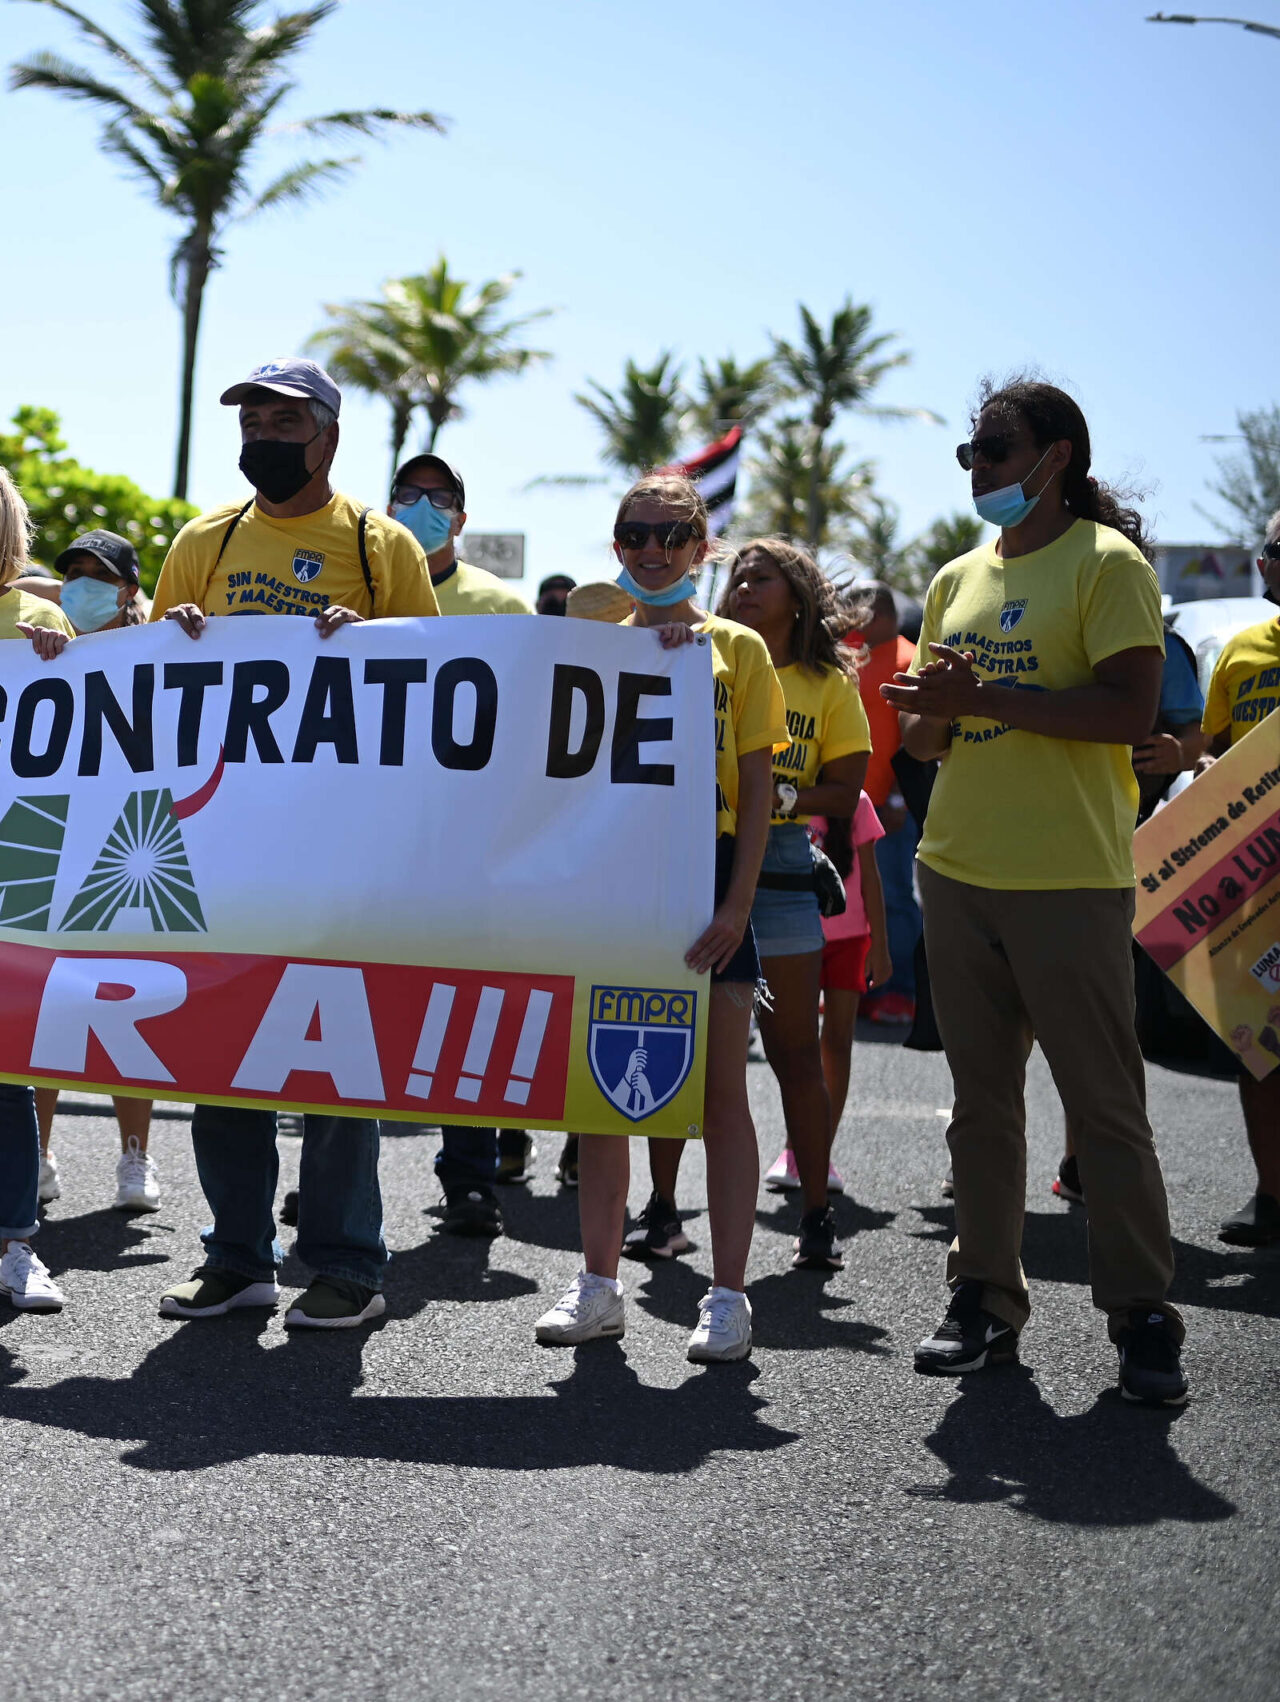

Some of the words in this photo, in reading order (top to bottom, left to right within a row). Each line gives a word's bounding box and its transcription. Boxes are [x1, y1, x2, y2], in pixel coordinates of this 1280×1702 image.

[226, 592, 236, 605] Y
[227, 571, 252, 588] SIN
[255, 572, 330, 605] MAESTROS
[965, 632, 1033, 655] MAESTROS
[546, 663, 675, 786] DE
[1171, 816, 1230, 867] Sistema
[1227, 801, 1247, 820] de
[1242, 765, 1280, 805] Retir
[1172, 895, 1220, 934] No
[1219, 876, 1244, 899] a
[598, 991, 689, 1024] FMPR
